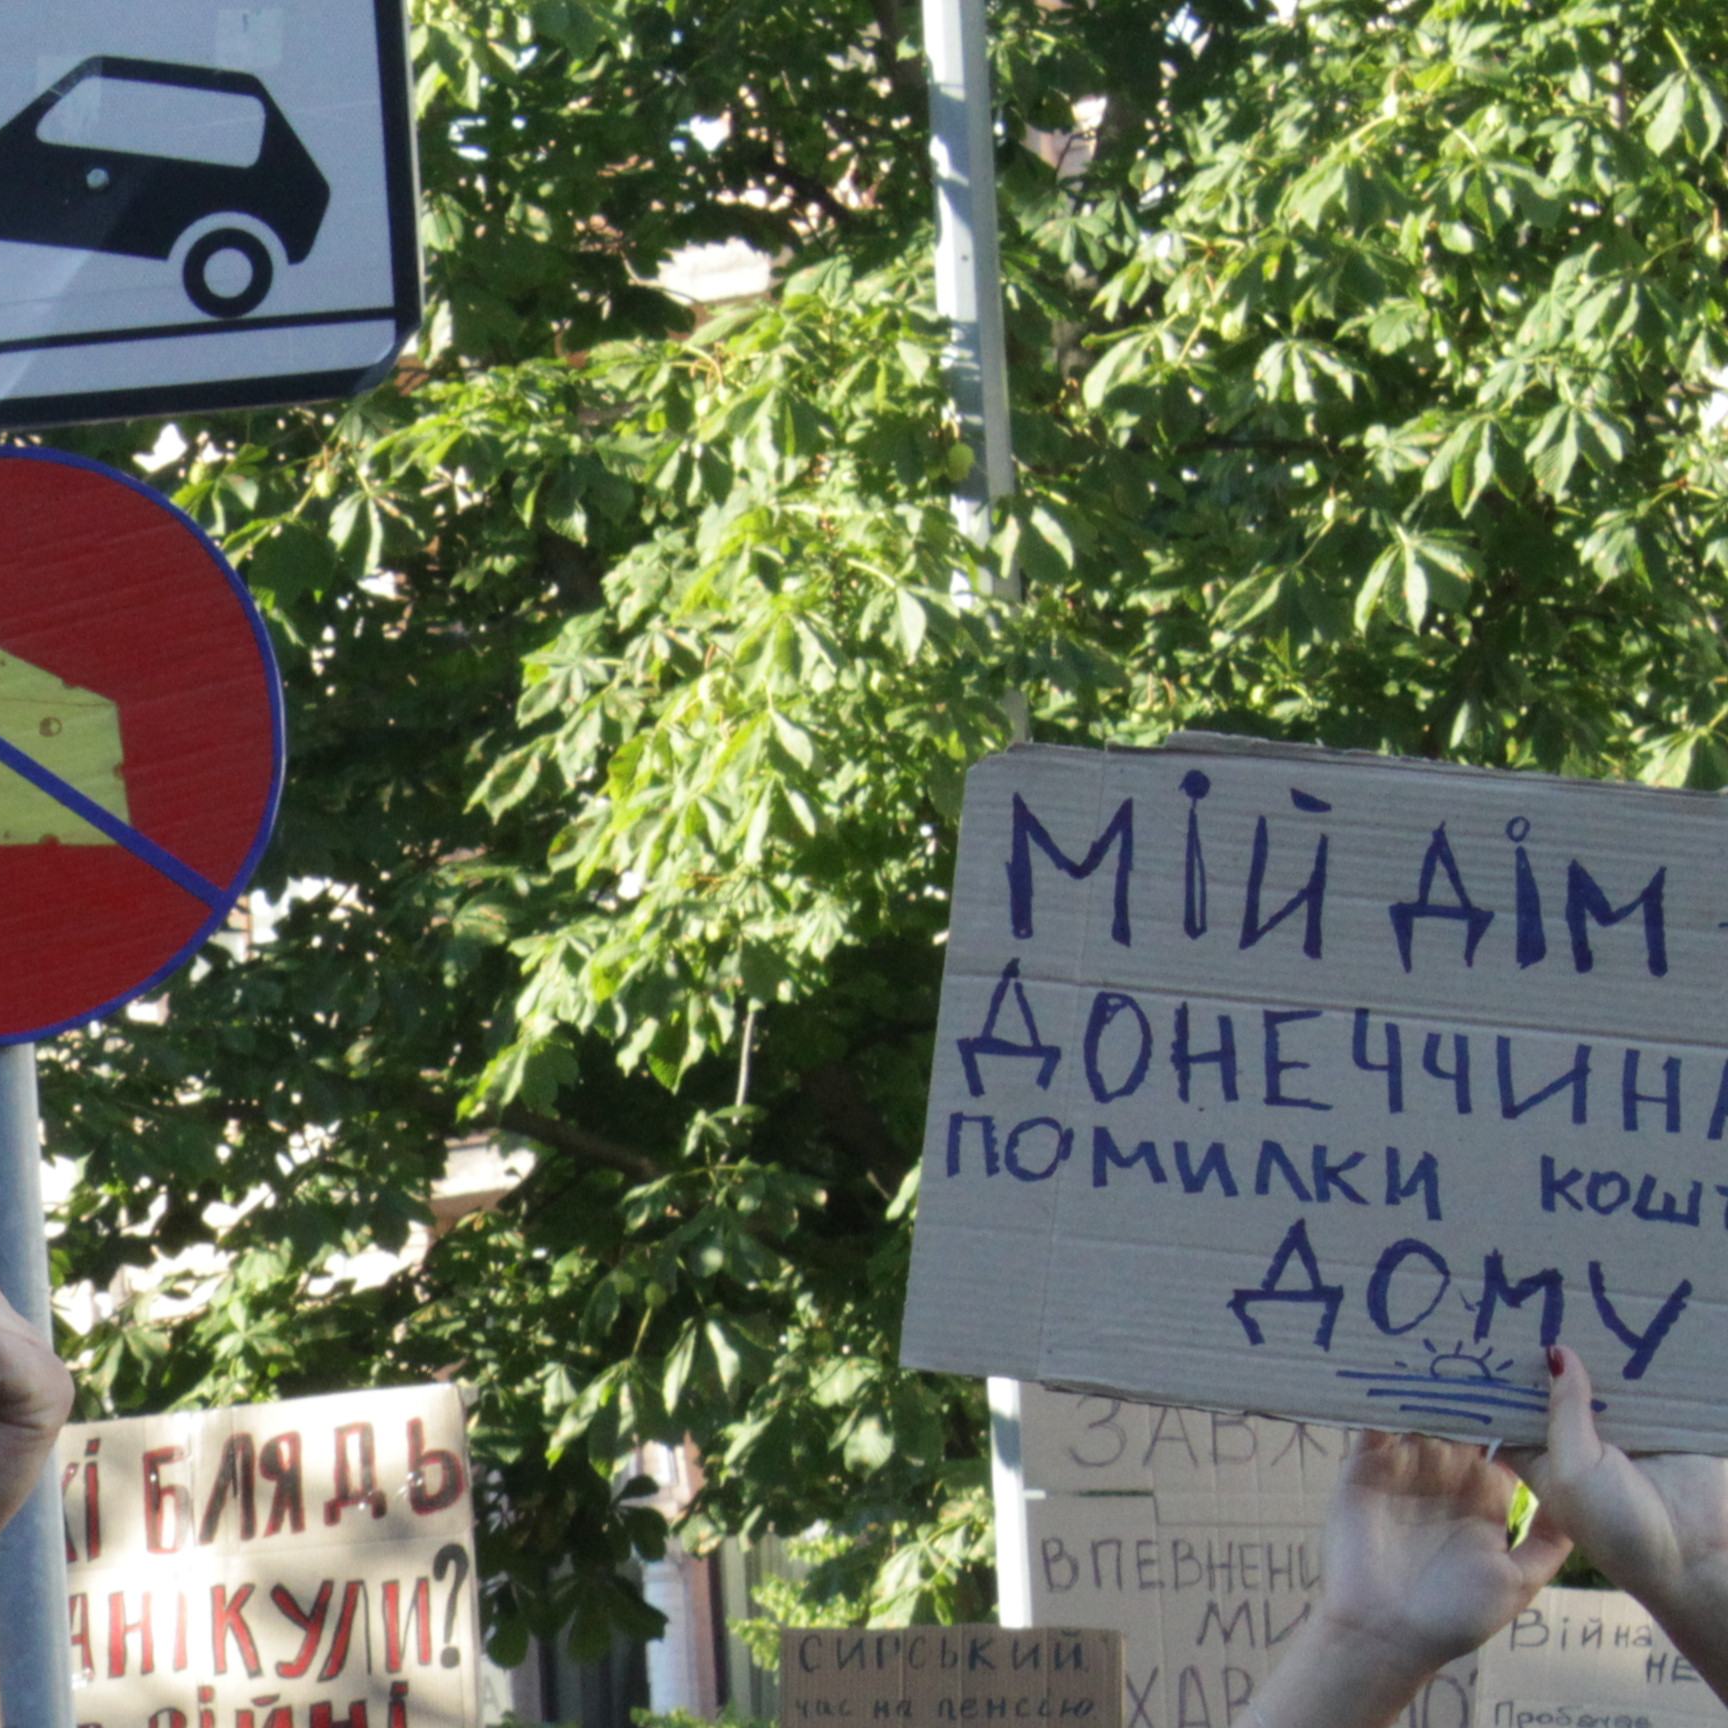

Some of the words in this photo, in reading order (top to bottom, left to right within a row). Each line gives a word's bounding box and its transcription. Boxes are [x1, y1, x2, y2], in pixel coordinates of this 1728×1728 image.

[1005, 768, 1333, 962] МІЙ
[1387, 815, 1670, 979] ДІМ
[946, 1111, 1442, 1223] ПОМИЛКИ
[1226, 1215, 1692, 1382] ДОМУ
[1067, 1399, 1351, 1471] ЗАВЖ
